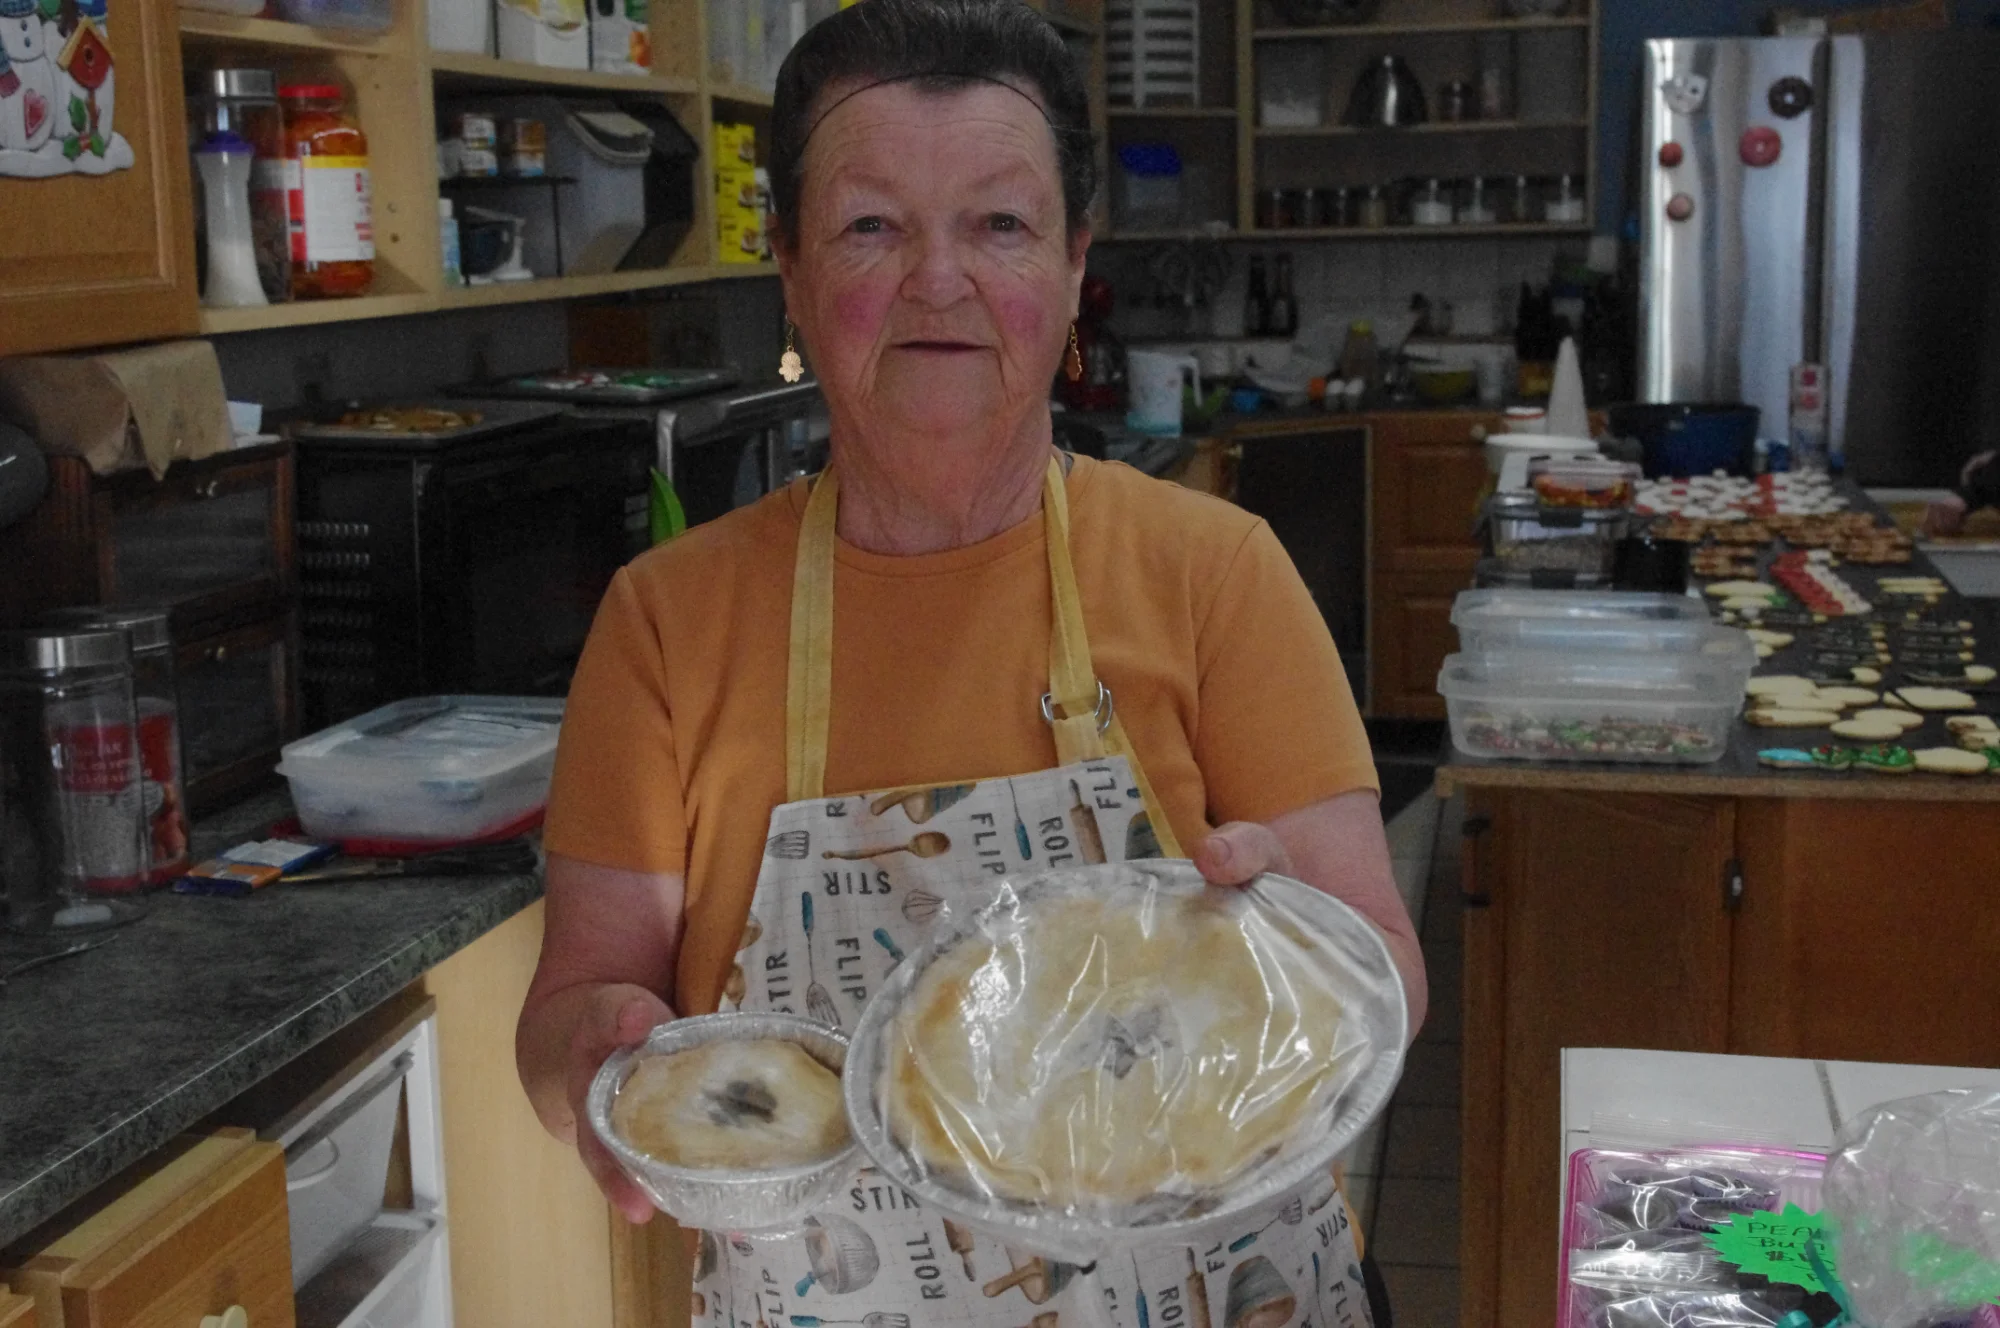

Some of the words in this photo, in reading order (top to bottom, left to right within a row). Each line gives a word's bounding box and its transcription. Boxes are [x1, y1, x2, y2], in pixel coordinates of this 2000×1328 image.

[1082, 757, 1121, 809] FLI
[970, 812, 1007, 875] FLIP
[1038, 816, 1074, 868] ROL
[822, 869, 892, 896] STIR
[835, 937, 867, 1001] FLIP
[1315, 1207, 1348, 1248] STIR
[905, 1231, 947, 1300] ROLL
[1204, 1240, 1227, 1273] FL
